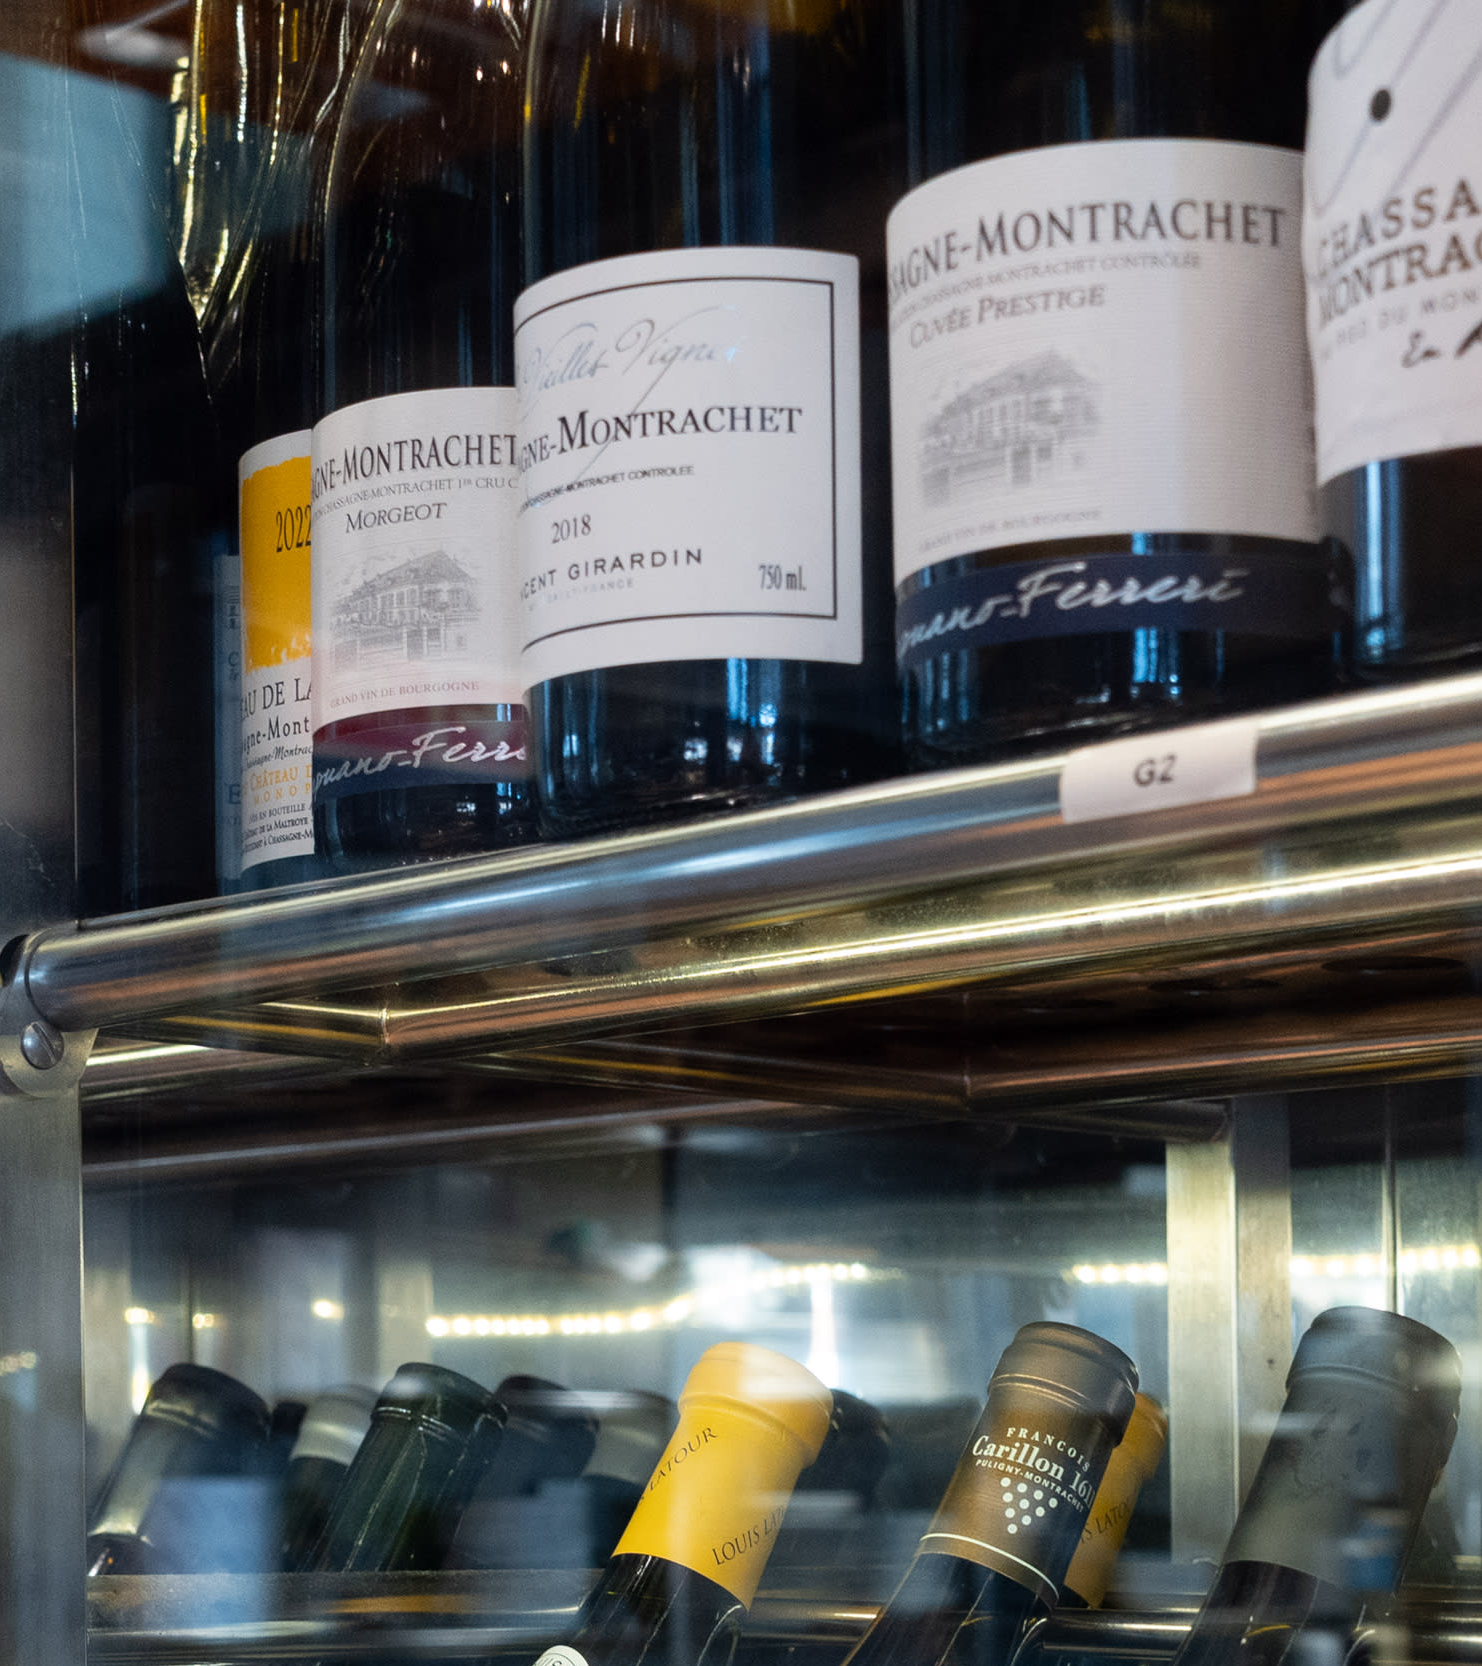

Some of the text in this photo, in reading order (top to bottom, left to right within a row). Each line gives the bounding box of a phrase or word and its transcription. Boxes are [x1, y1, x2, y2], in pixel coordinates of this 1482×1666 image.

[977, 284, 1107, 325] PRESTIGE
[276, 504, 312, 553] 2022
[345, 501, 448, 534] MORGEOT
[550, 514, 592, 544] 2018
[567, 548, 703, 581] GIRARDIN
[757, 563, 783, 591] 750
[262, 680, 286, 711] DE
[380, 687, 395, 699] DE
[399, 680, 481, 697] BOURGOGNE
[649, 1426, 718, 1492] LATOUR
[972, 1434, 1066, 1482] Carillon
[975, 1458, 1085, 1514] PULIGNY-MONTRACHET
[712, 1523, 761, 1566] LOUIS
